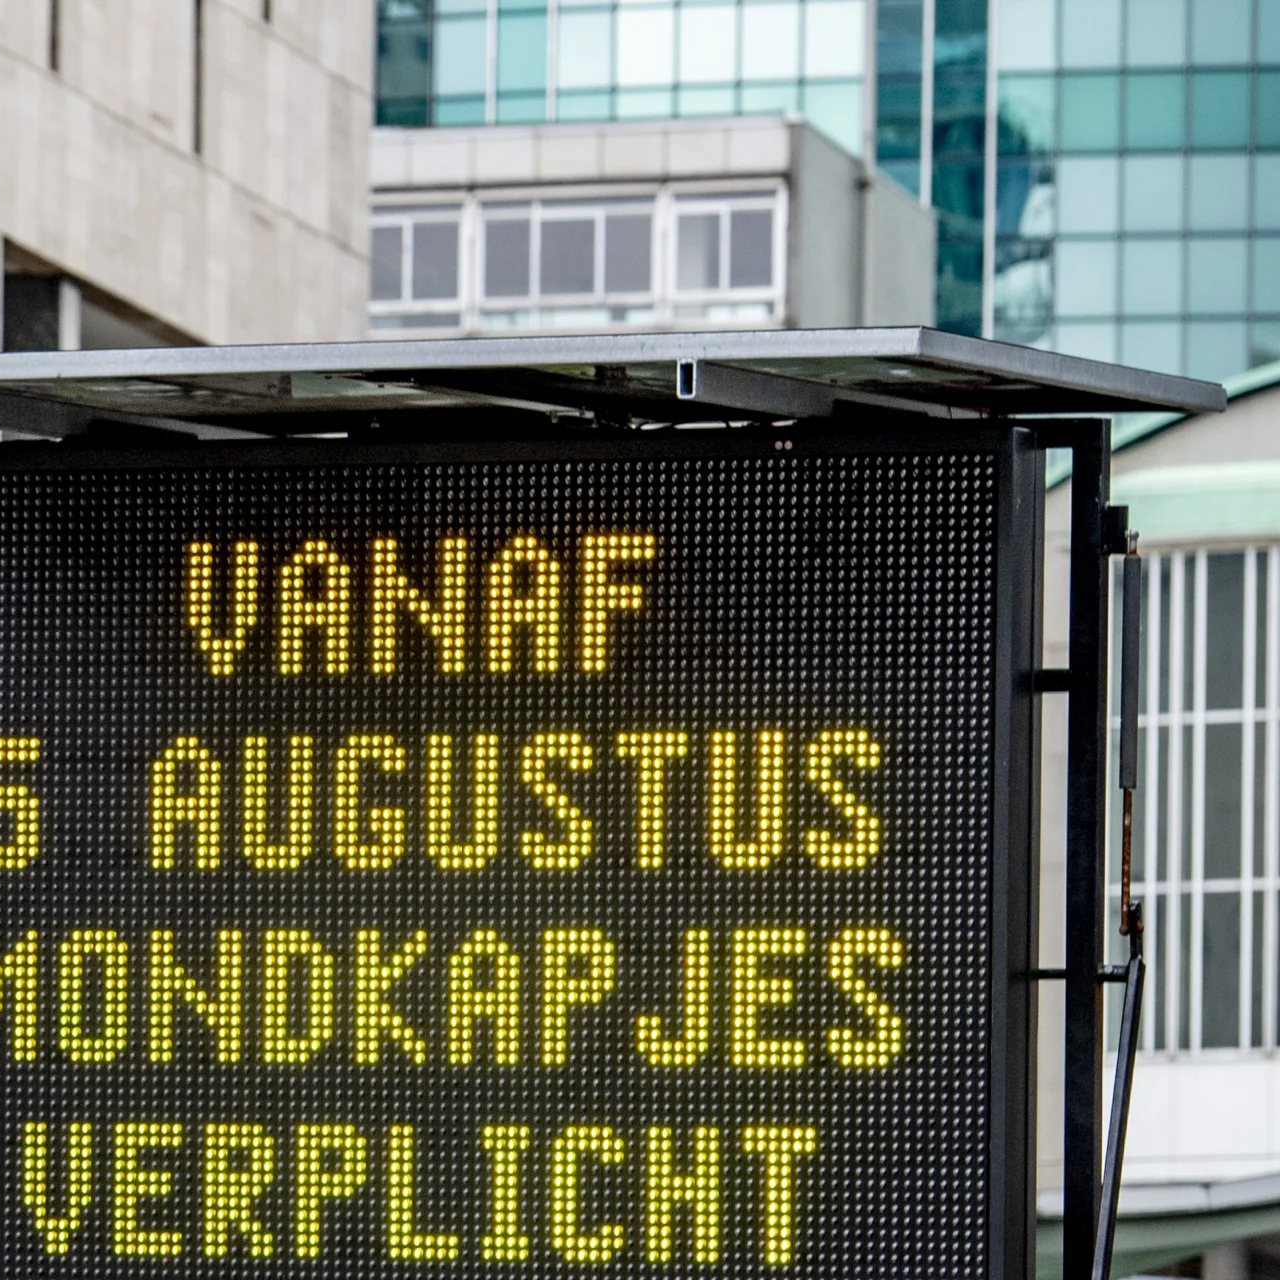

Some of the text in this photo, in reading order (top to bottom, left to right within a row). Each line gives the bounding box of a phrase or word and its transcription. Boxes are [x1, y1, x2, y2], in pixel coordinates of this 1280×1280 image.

[187, 534, 656, 675] VANAF
[148, 729, 884, 871] AUGUSTUS
[22, 1121, 817, 1267] VERPLICHT
